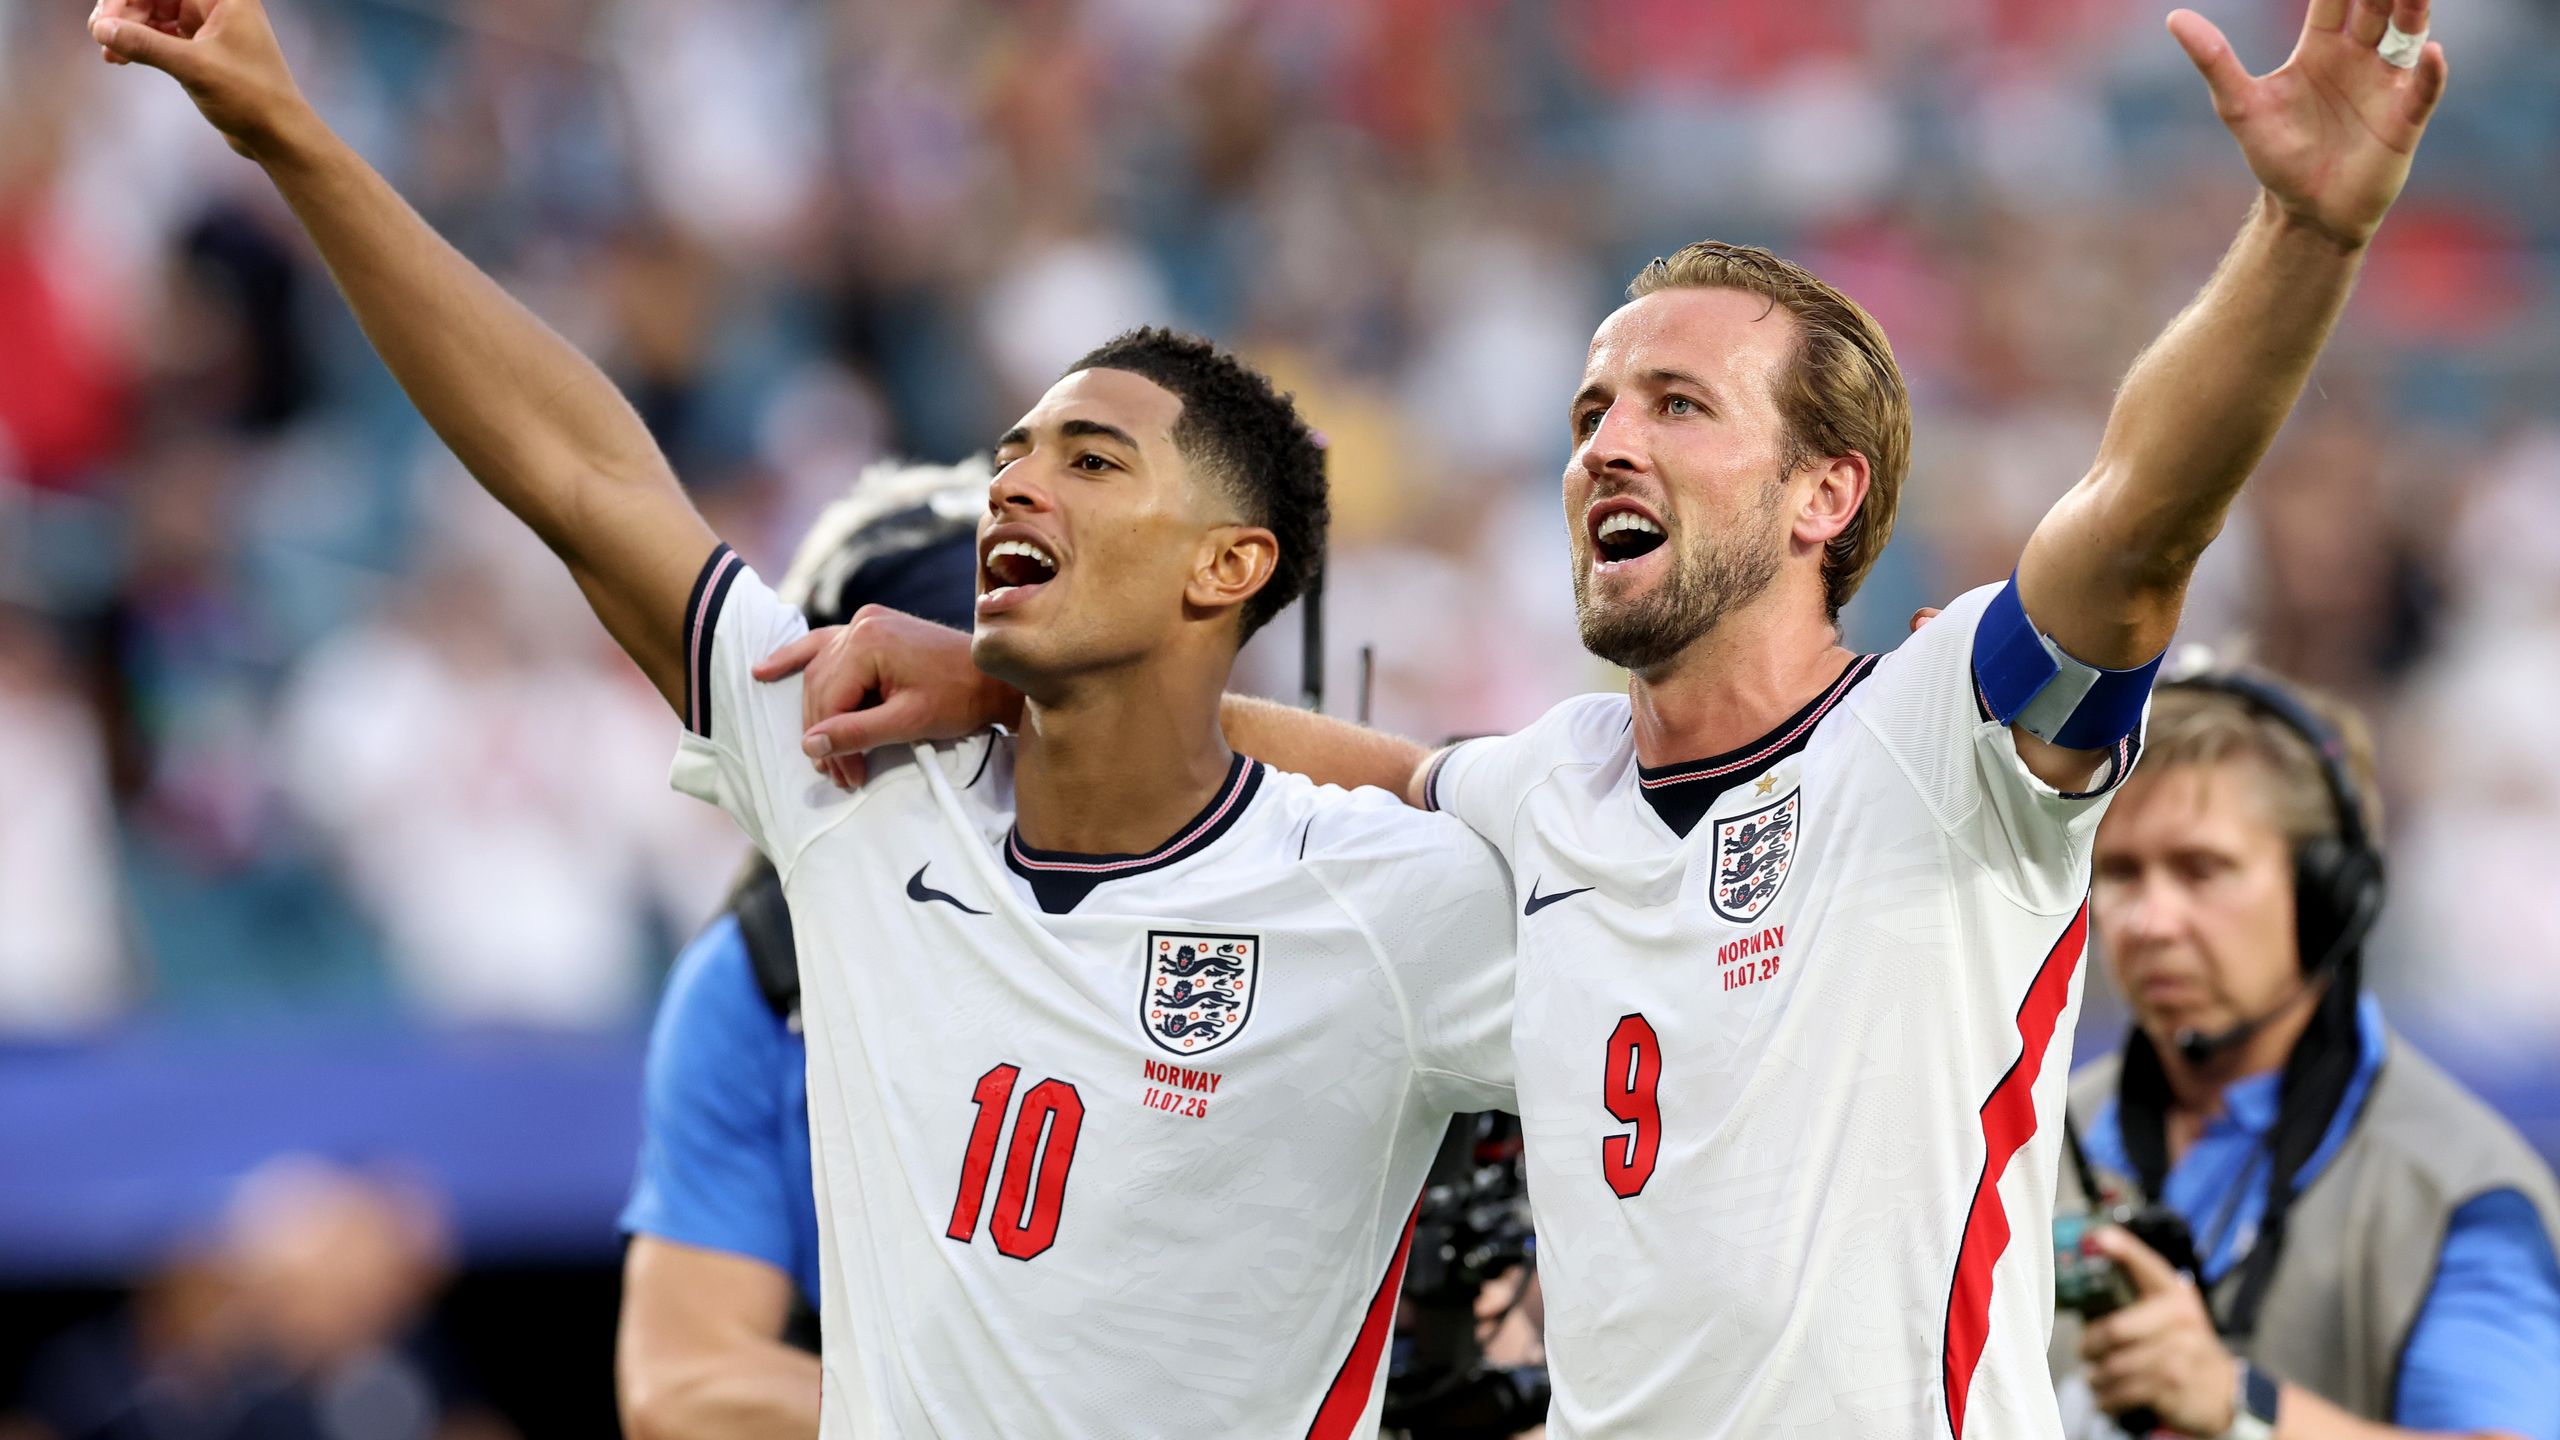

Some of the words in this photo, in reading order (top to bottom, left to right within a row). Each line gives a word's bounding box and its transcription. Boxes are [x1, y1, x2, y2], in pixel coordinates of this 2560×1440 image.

[1717, 925, 1785, 966] NORWAY
[1723, 956, 1780, 991] 11.07.26
[1144, 1059, 1222, 1093] NORWAY
[1143, 1087, 1208, 1118] 11.07.26
[1602, 1012, 1662, 1199] 9
[946, 1062, 1085, 1261] 10
